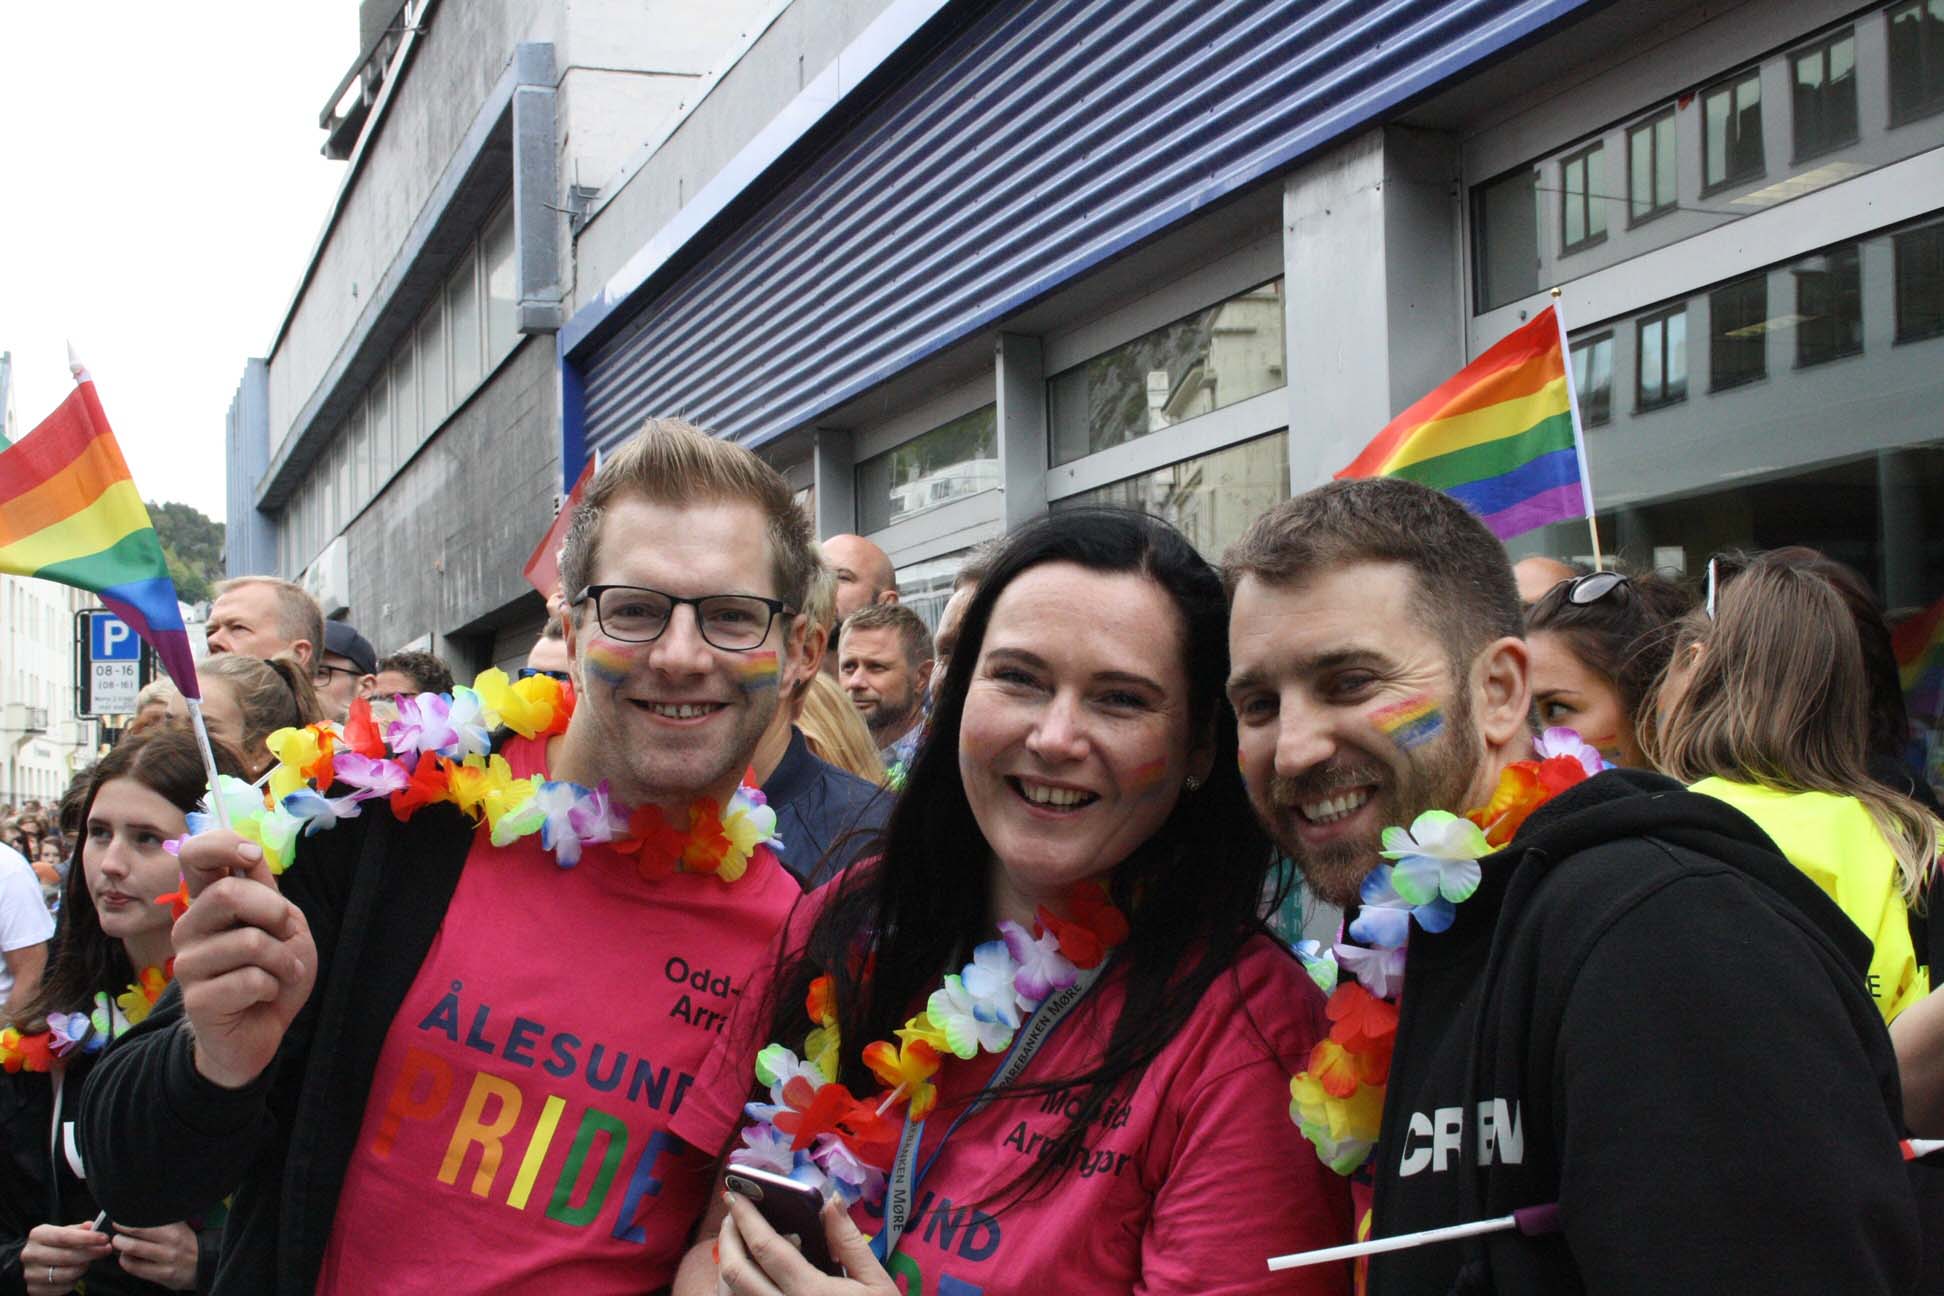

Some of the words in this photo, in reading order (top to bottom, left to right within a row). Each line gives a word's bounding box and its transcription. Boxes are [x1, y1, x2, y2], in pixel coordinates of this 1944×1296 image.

[104, 620, 129, 656] P
[1047, 983, 1082, 1016] MØRE
[372, 1046, 686, 1244] PRIDE
[893, 1190, 906, 1232] MØRE
